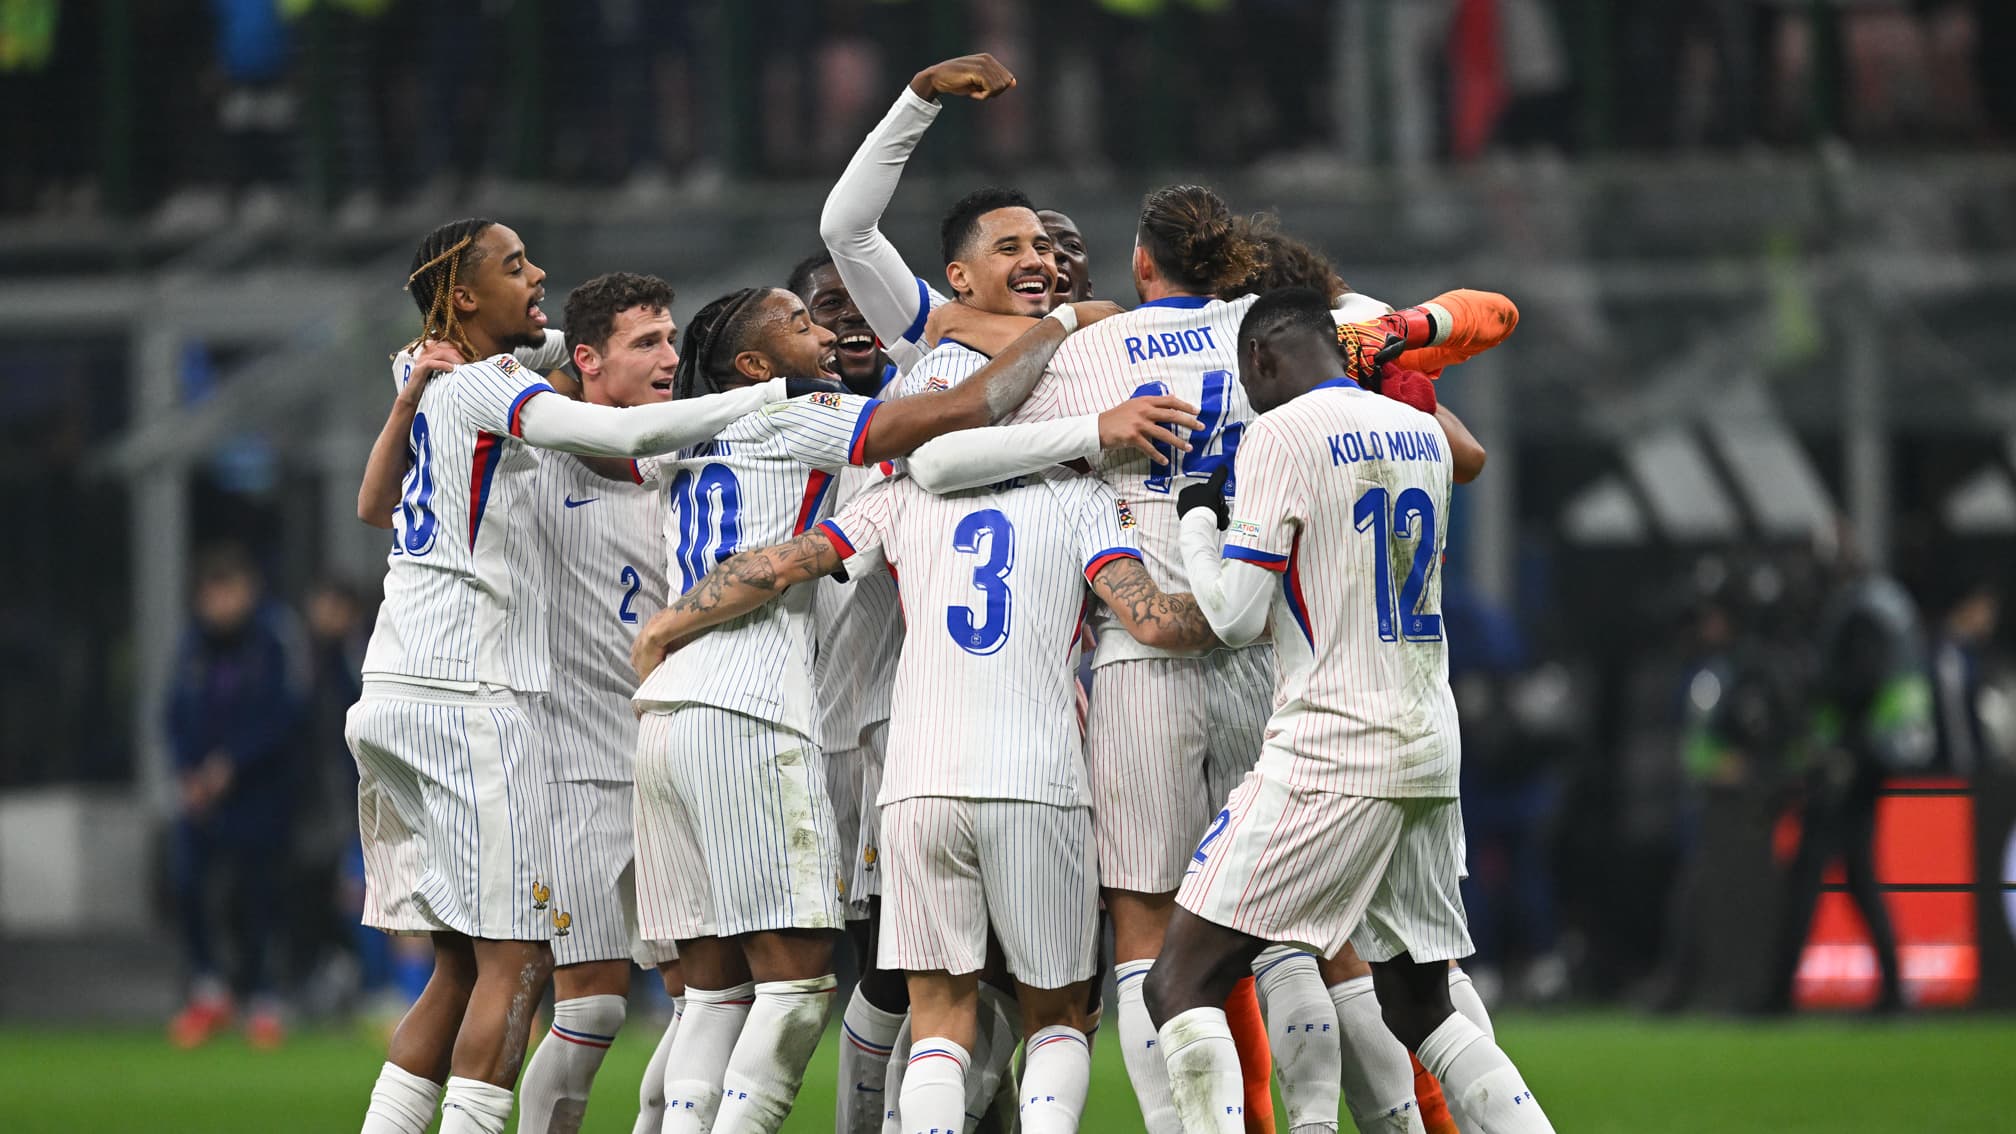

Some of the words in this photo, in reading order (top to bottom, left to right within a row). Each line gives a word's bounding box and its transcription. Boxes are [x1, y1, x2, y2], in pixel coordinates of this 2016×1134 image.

[1125, 326, 1216, 364] RABIOT
[1129, 369, 1246, 501] 14
[1328, 431, 1383, 466] KOLO
[1385, 432, 1441, 463] MUANI
[619, 565, 642, 624] 2
[671, 462, 743, 596] 10
[947, 508, 1015, 656] 3
[1354, 487, 1443, 642] 12
